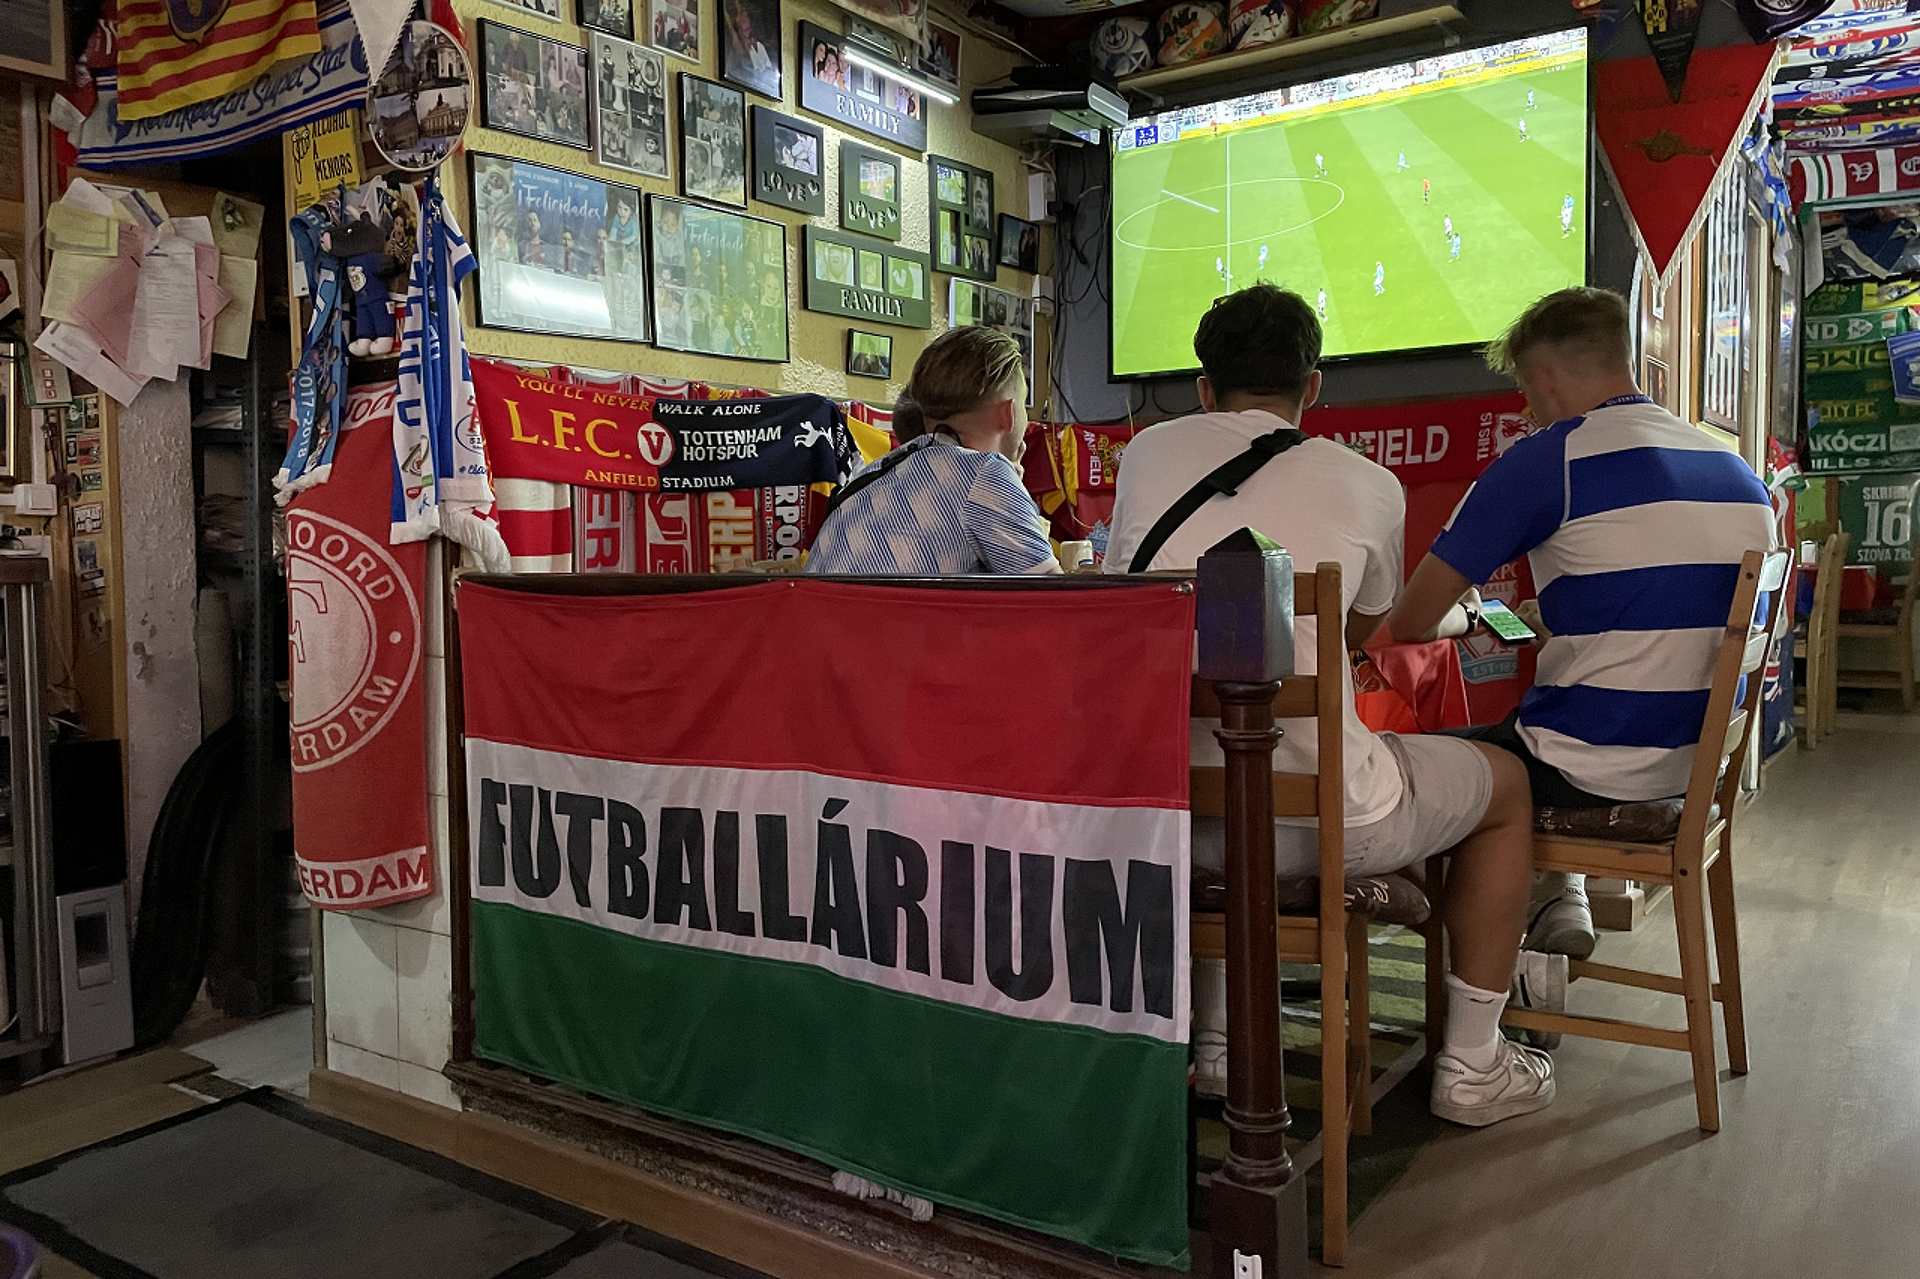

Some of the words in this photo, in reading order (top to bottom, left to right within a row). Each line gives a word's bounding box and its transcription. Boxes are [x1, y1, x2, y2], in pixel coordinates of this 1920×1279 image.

[246, 73, 307, 117] Super
[302, 42, 350, 95] Star
[312, 110, 350, 139] ALCOHOL
[836, 92, 902, 134] FAMILY
[1139, 128, 1155, 139] 3-3
[314, 153, 353, 182] MENORS
[762, 171, 806, 201] LOVE
[849, 201, 886, 228] LOVE
[840, 288, 905, 318] FAMILY
[516, 375, 584, 400] YOU'LL
[593, 392, 650, 411] NEVER
[658, 403, 705, 416] WALK
[712, 404, 761, 416] ALONE
[298, 365, 315, 458] 2017-2018
[1480, 412, 1493, 426] IS
[503, 398, 632, 460] L.F.C.
[679, 426, 782, 447] TOTTENHAM
[683, 444, 759, 461] HOTSPUR
[1477, 428, 1491, 461] THIS
[585, 469, 658, 487] ANFIELD
[662, 475, 736, 489] STADIUM
[1861, 501, 1911, 546] 16
[288, 520, 396, 600] OORD
[1858, 548, 1892, 562] SZOVA
[478, 777, 1174, 1020] FUTBALLÁRIUM
